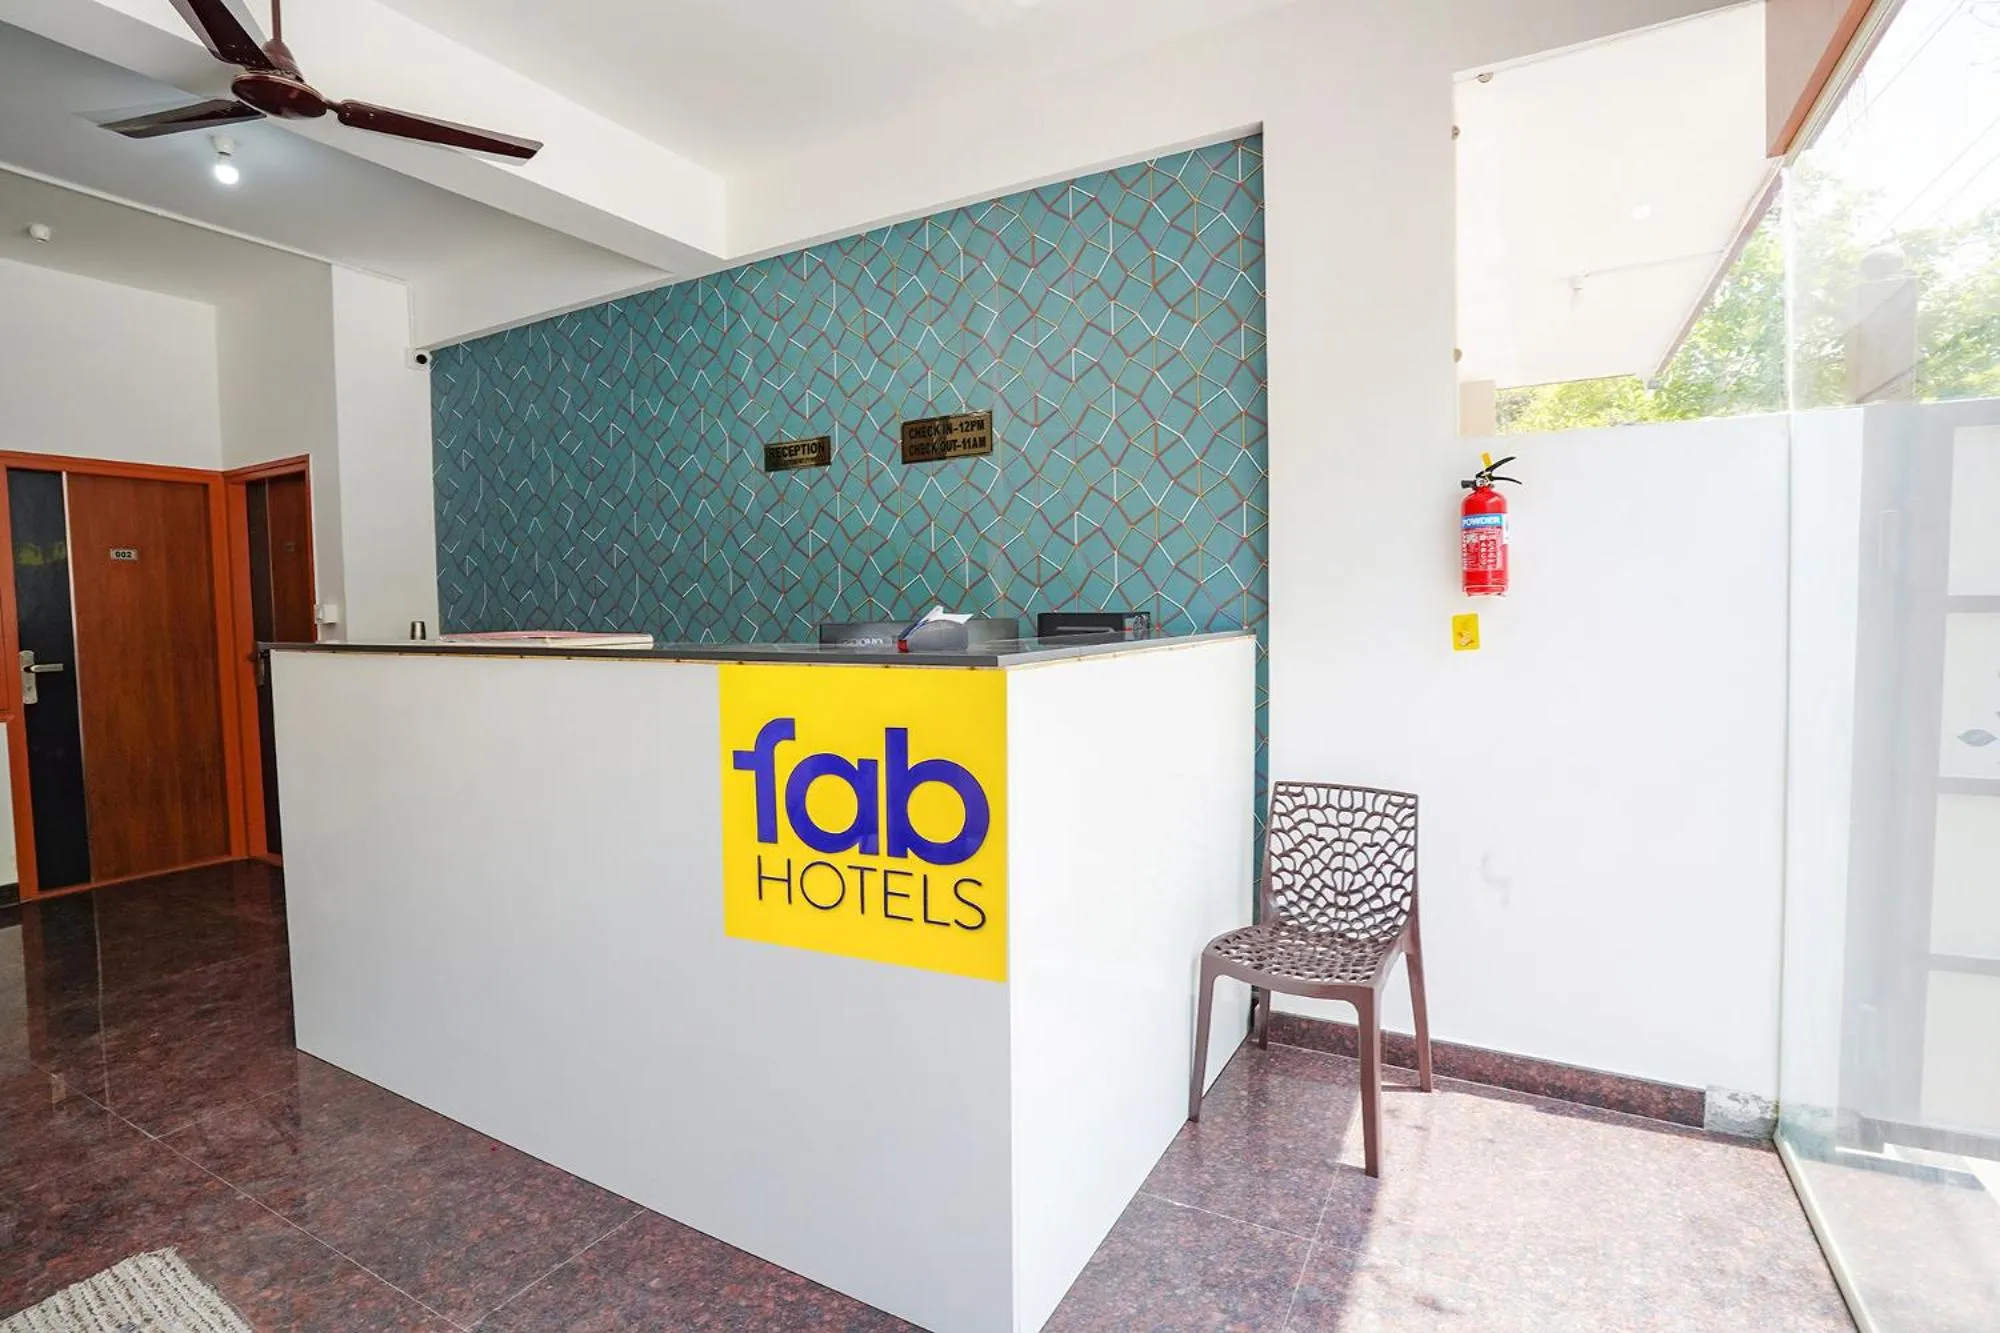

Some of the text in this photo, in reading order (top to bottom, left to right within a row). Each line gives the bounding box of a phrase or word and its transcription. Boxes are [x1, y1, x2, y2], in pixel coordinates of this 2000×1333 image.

[909, 423, 940, 439] CHECK
[768, 441, 825, 458] RECEPTION
[909, 441, 939, 456] CHECK
[1463, 517, 1501, 527] POWDER
[732, 717, 990, 865] fab
[757, 855, 986, 930] HOTELS
